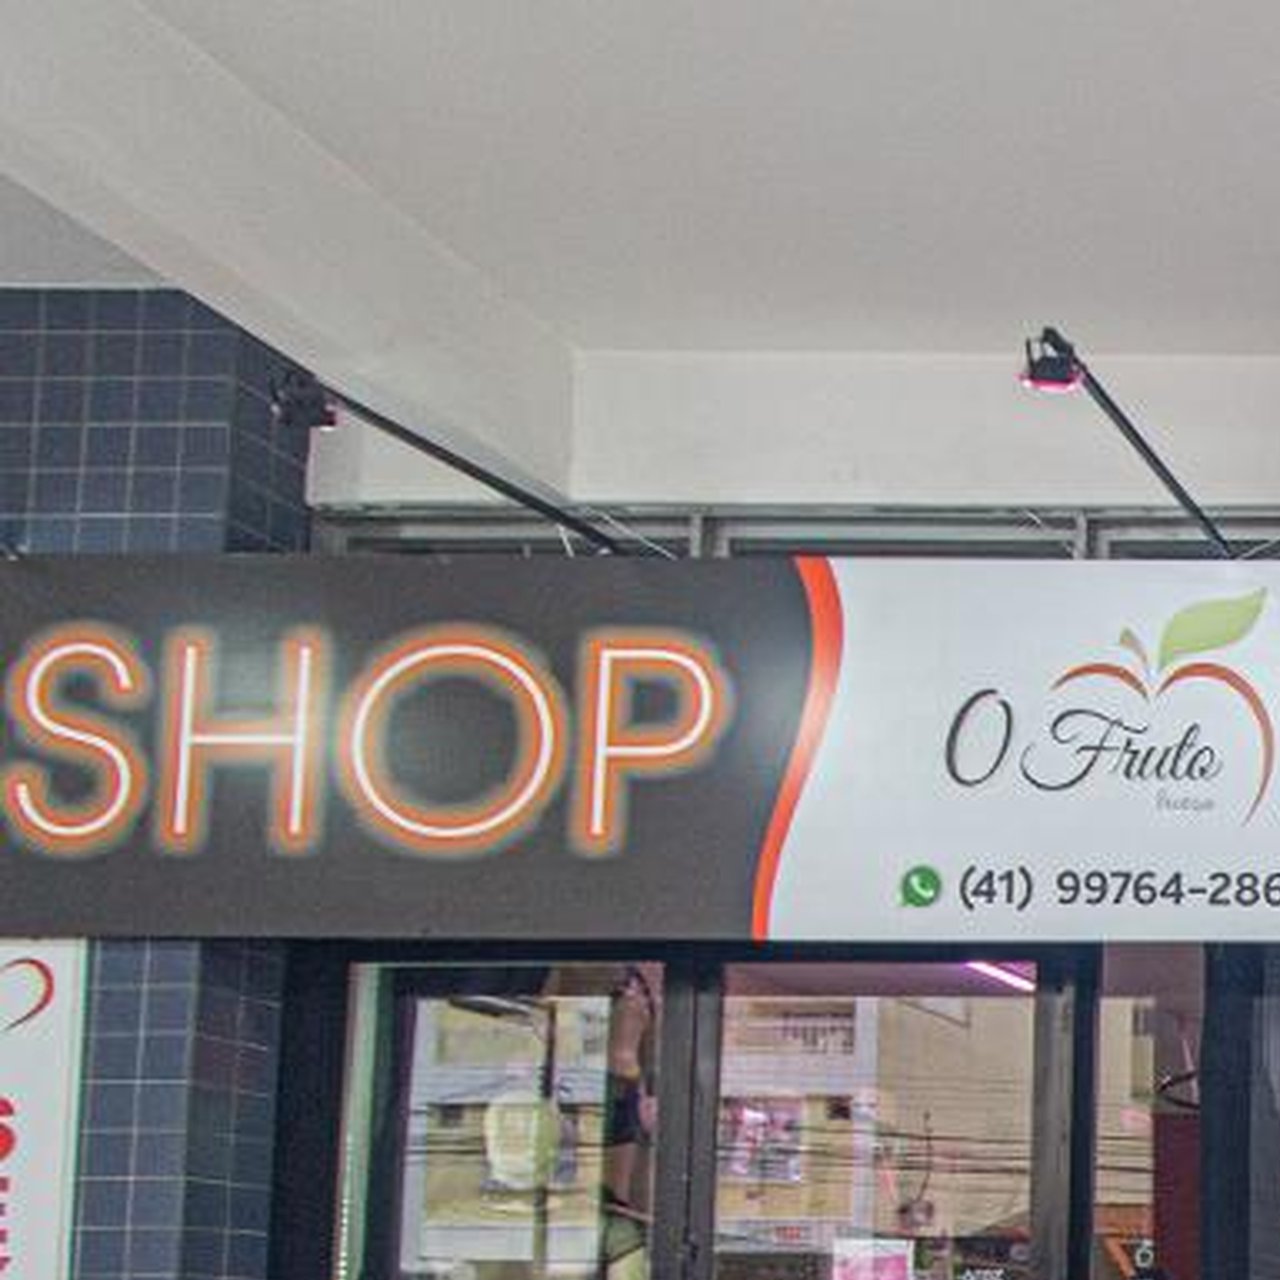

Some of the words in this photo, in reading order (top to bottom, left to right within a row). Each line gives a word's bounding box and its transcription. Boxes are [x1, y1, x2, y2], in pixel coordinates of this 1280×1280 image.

[4, 626, 727, 852] SHOP
[945, 688, 1014, 787] O
[1020, 708, 1222, 791] Fruto
[959, 866, 1032, 912] (41)
